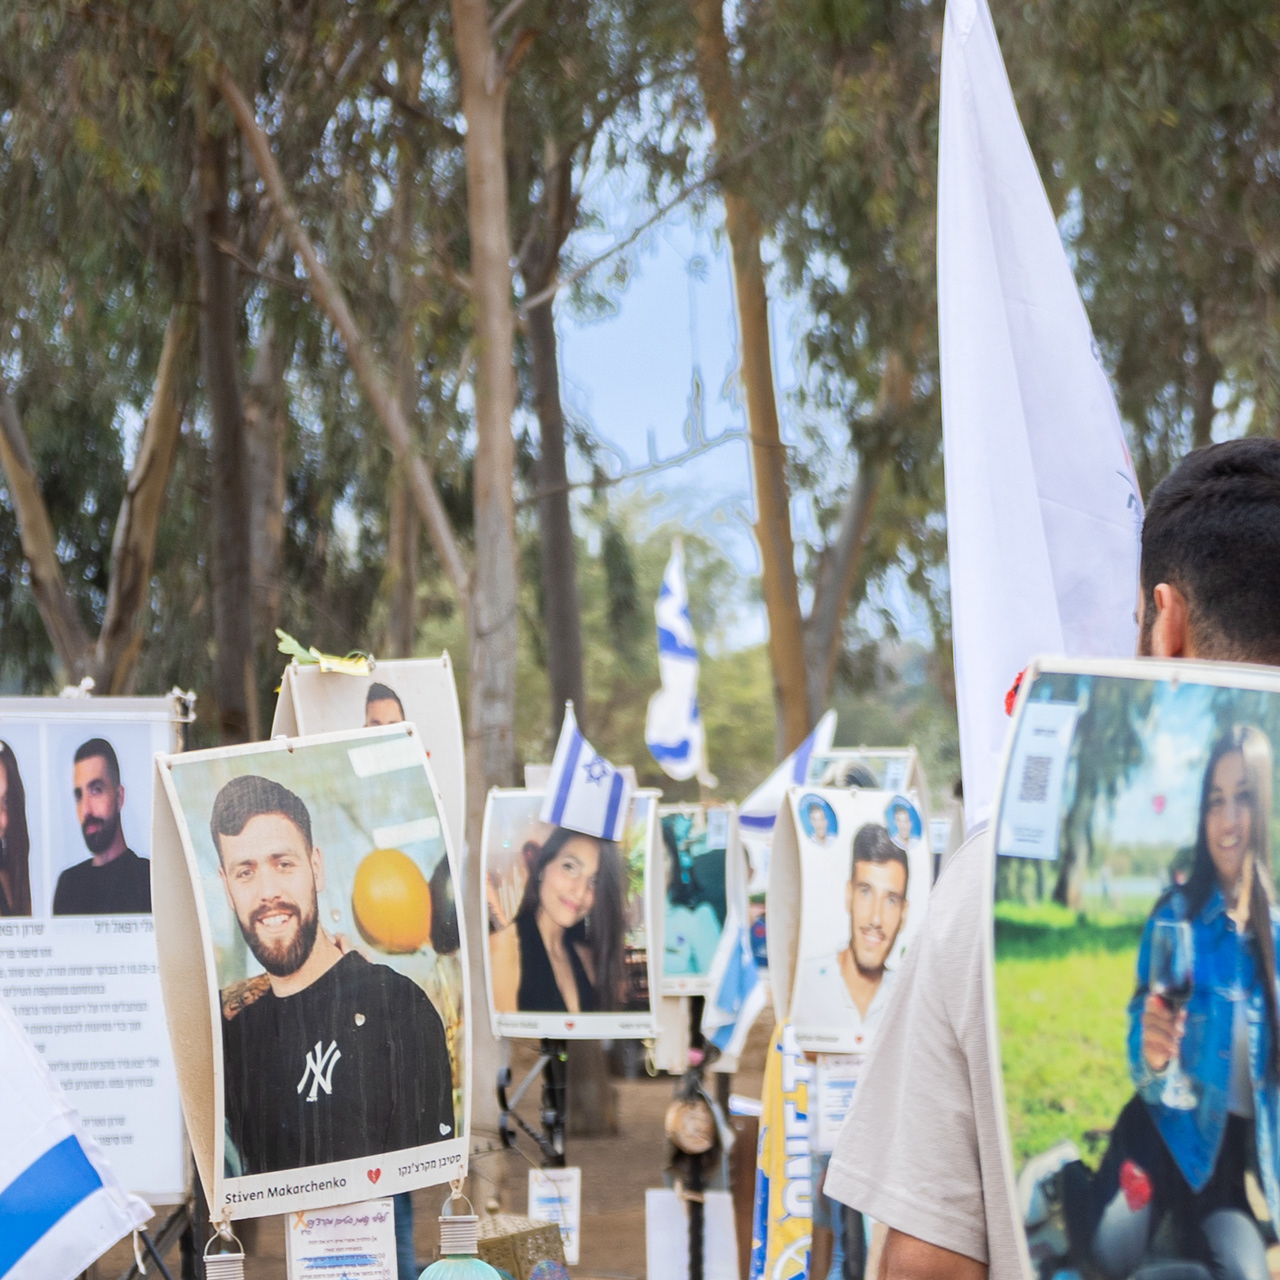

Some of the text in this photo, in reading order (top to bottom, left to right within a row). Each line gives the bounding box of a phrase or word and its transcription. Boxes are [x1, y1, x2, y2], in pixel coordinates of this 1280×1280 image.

[22, 923, 45, 938] שרון
[297, 1040, 342, 1102] NY
[397, 1153, 462, 1177] סטיבן מקרצ'נקו
[225, 1177, 347, 1204] Stiven Makarchenko
